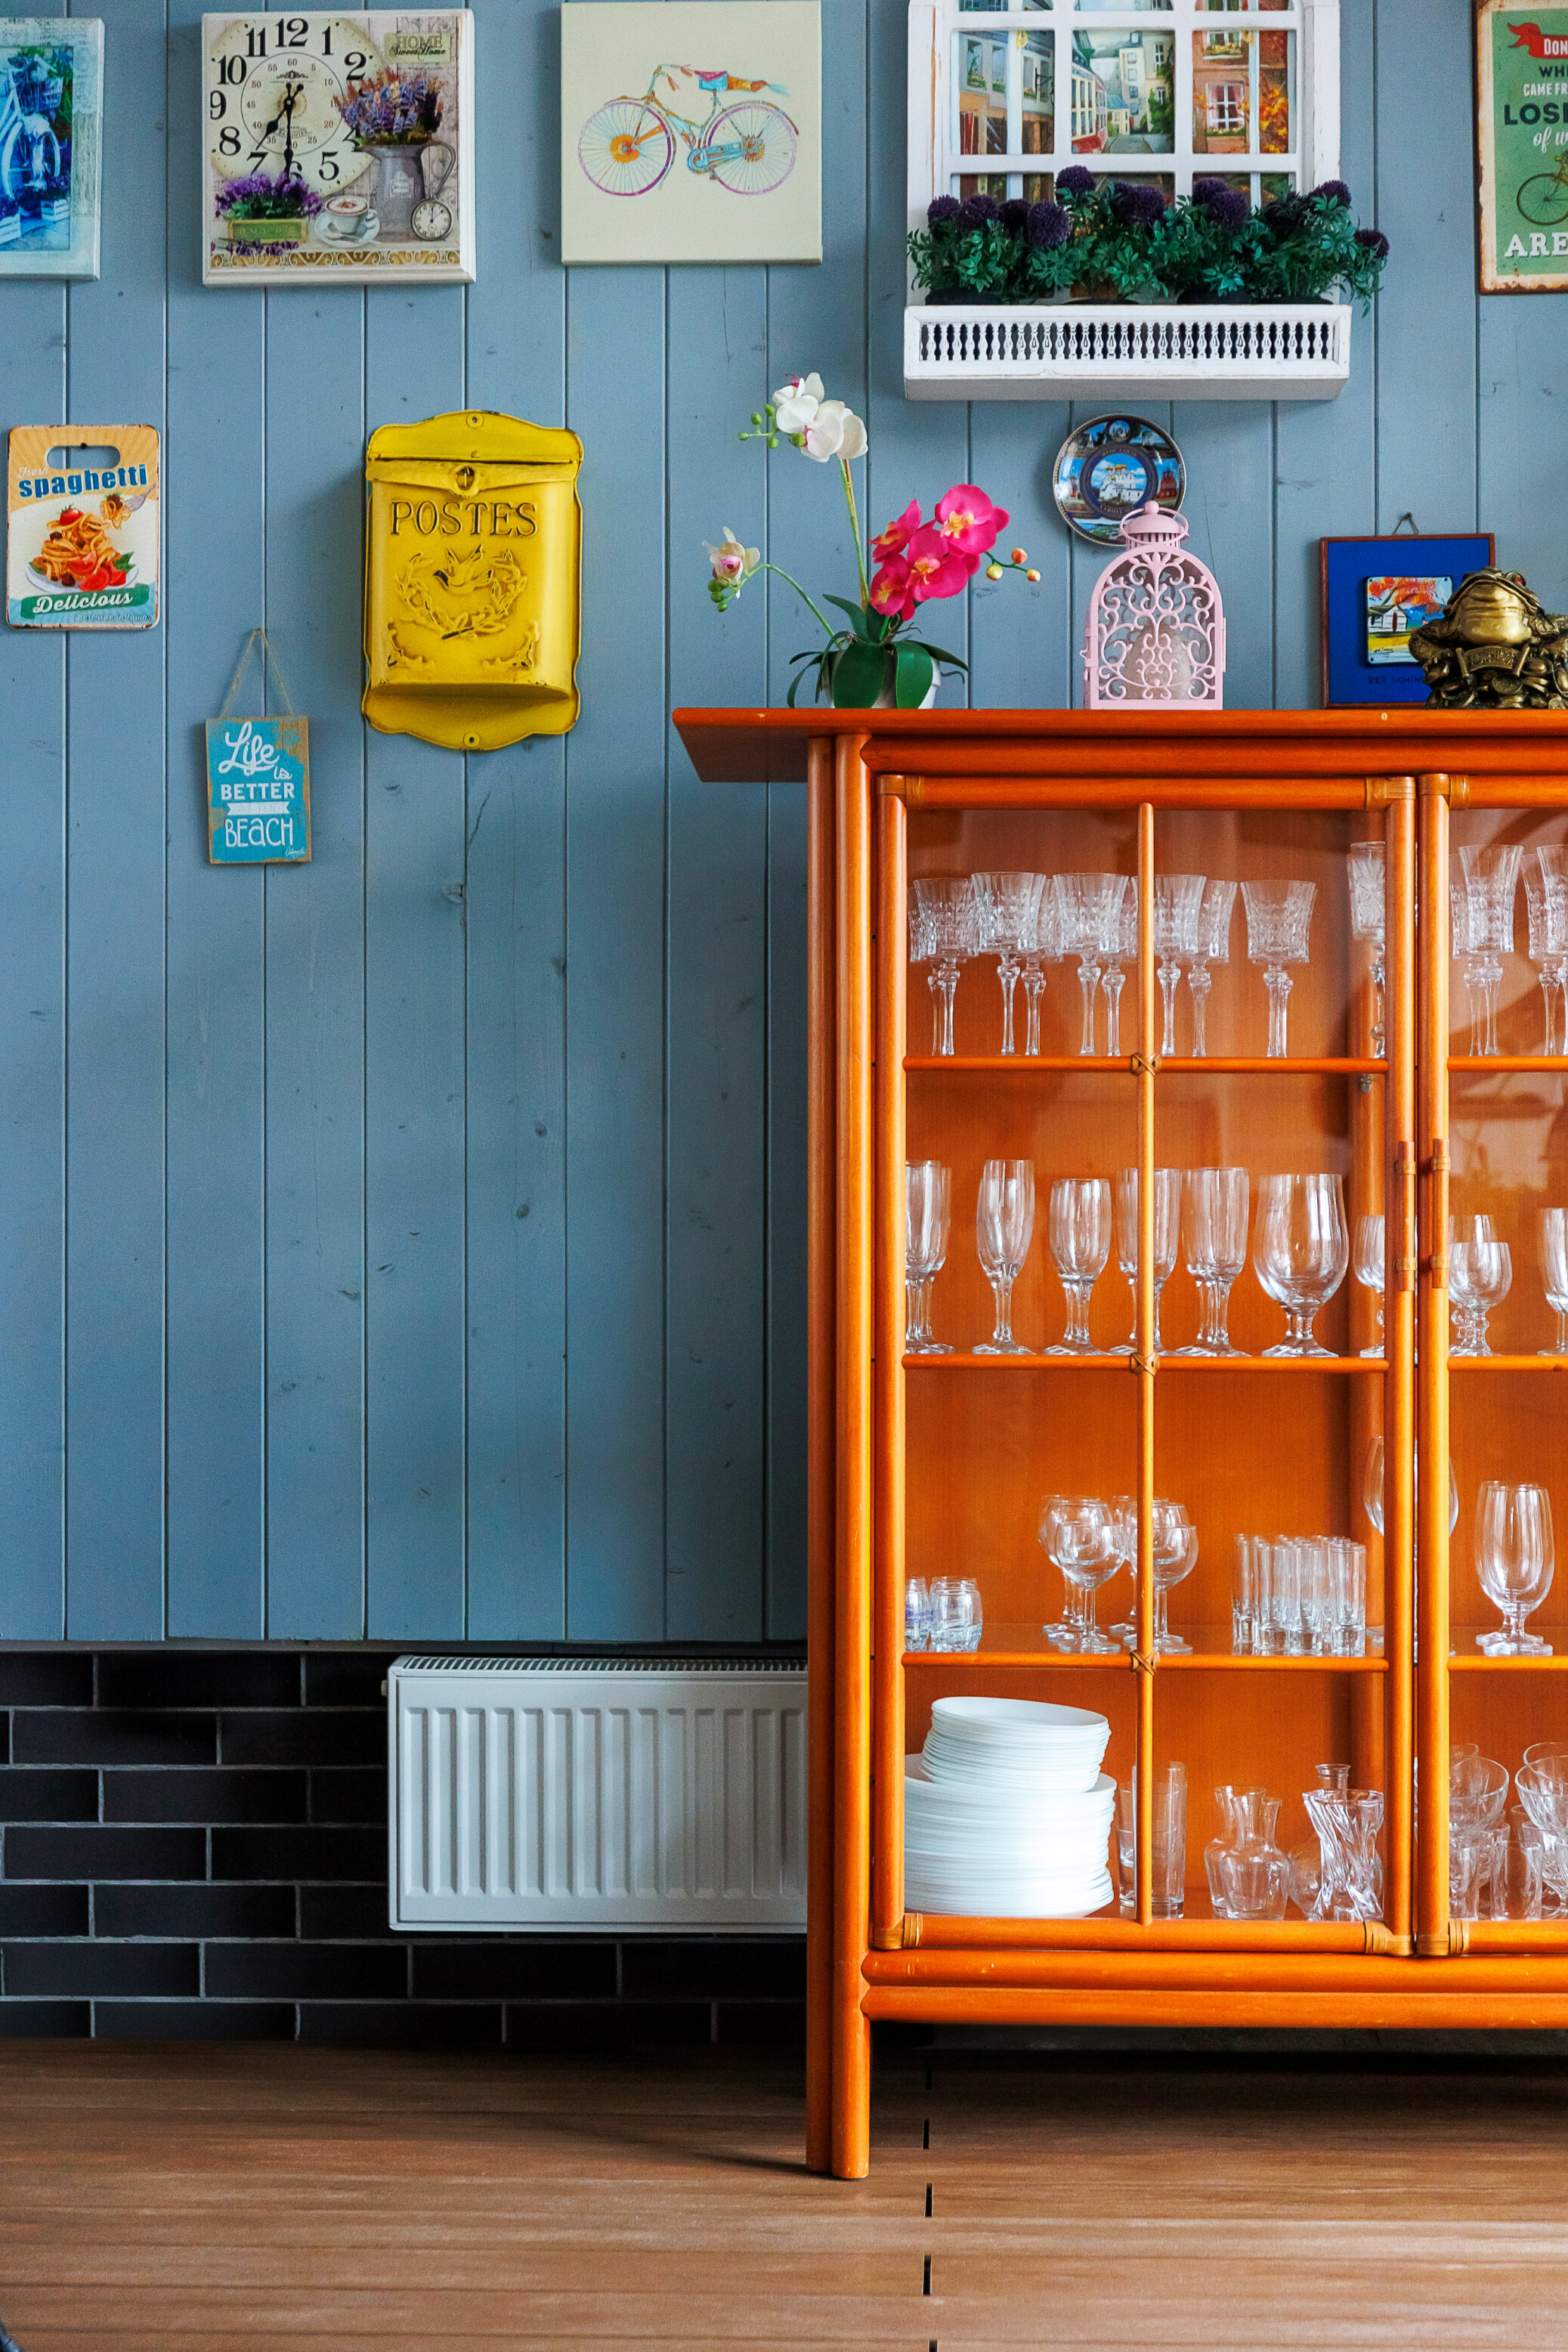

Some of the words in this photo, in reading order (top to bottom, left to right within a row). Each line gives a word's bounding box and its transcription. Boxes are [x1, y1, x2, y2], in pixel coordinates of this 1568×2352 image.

[246, 27, 268, 57] 11
[275, 18, 308, 47] 12
[322, 26, 333, 55] 1
[397, 35, 442, 48] HOME
[344, 51, 366, 80] 2
[390, 45, 418, 57] Sweet
[418, 45, 446, 60] Home
[218, 54, 247, 85] 10
[1539, 66, 1568, 78] WH
[1523, 83, 1551, 96] CAME
[210, 90, 227, 119] 9
[219, 126, 241, 156] 8
[1533, 126, 1551, 153] of
[246, 152, 268, 175] 7
[318, 152, 339, 181] 5
[1505, 232, 1568, 257] ARE
[18, 466, 48, 478] Fresh
[18, 464, 147, 498] spaghetti
[391, 500, 538, 537] POSTES
[32, 593, 133, 614] Delicious
[218, 721, 280, 776] Life
[274, 766, 292, 780] is
[221, 783, 295, 800] BETTER
